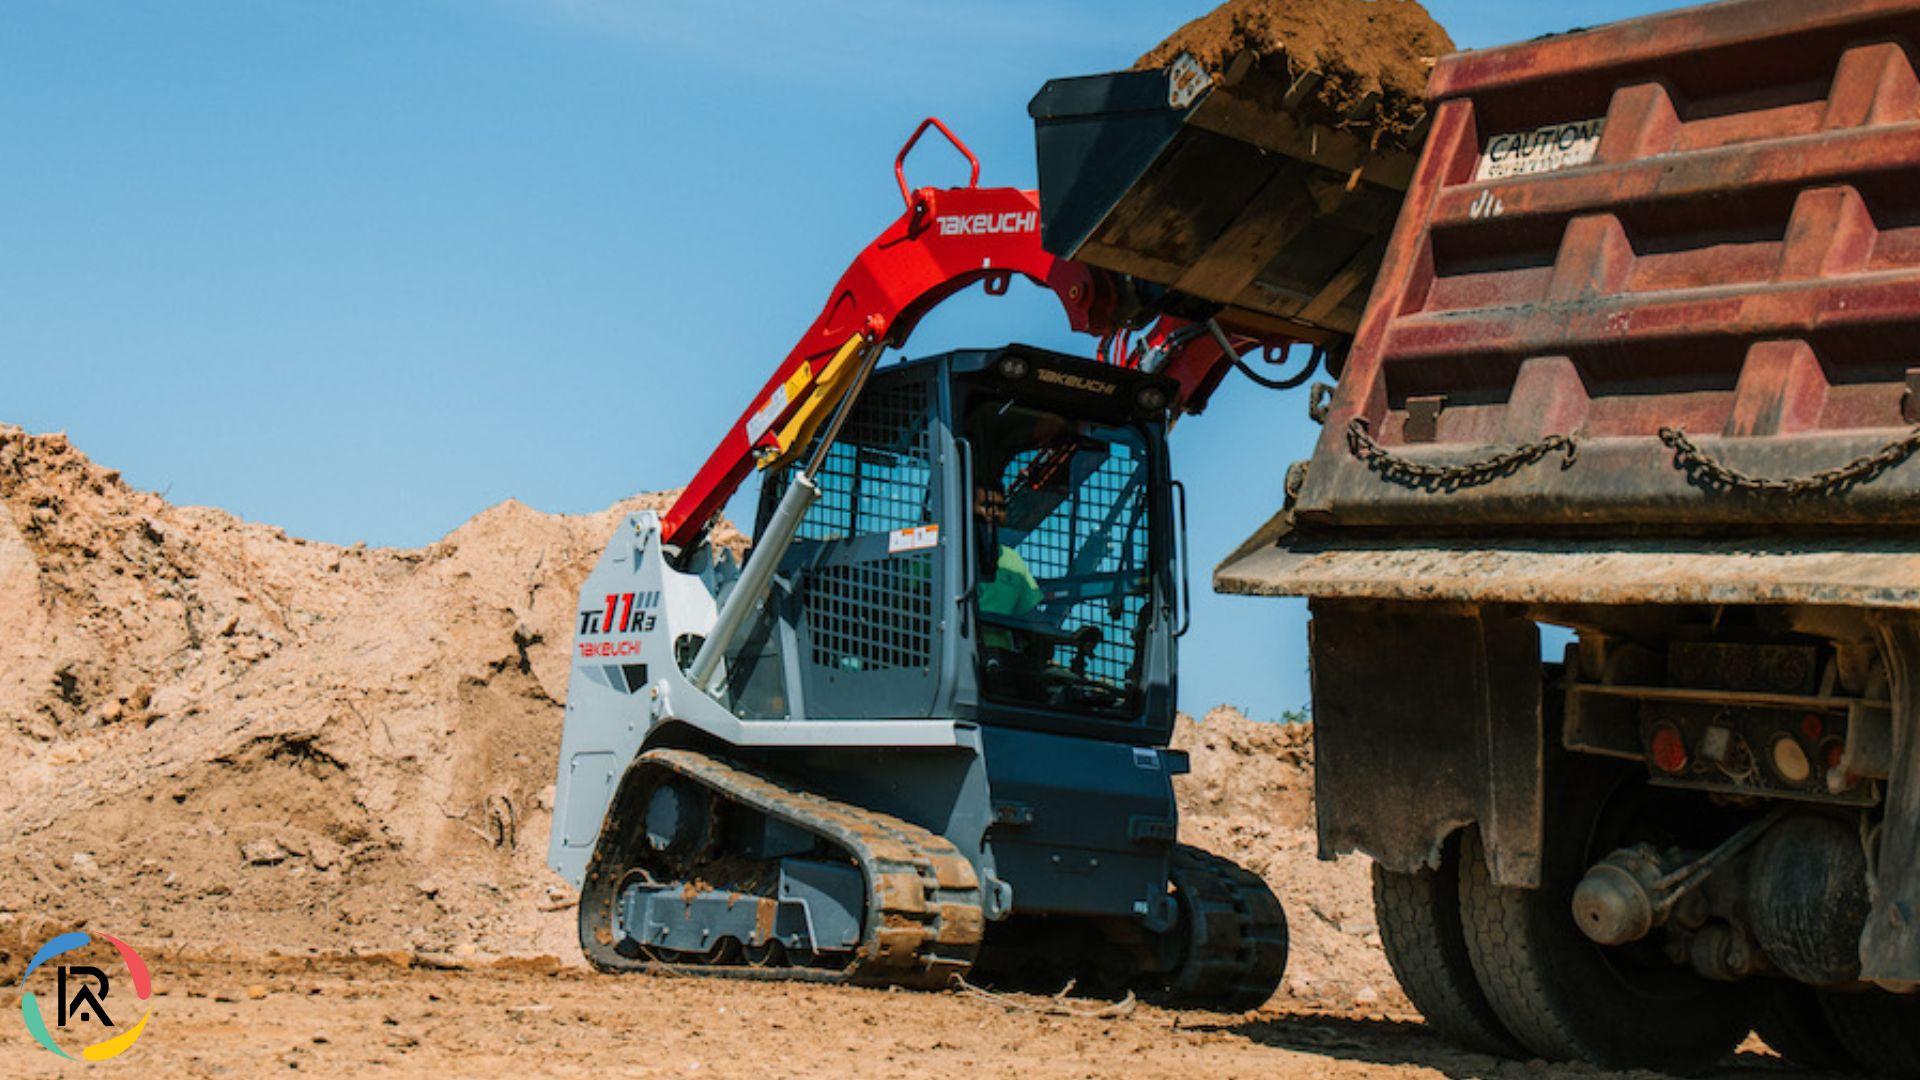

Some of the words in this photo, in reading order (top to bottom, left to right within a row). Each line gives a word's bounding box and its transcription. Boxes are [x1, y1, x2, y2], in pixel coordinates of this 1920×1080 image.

[1489, 124, 1602, 163] CAUTION
[936, 211, 1037, 235] TAKEUCHI
[1038, 368, 1117, 395] TAKEUCHI
[579, 640, 641, 657] TAKEUCHI
